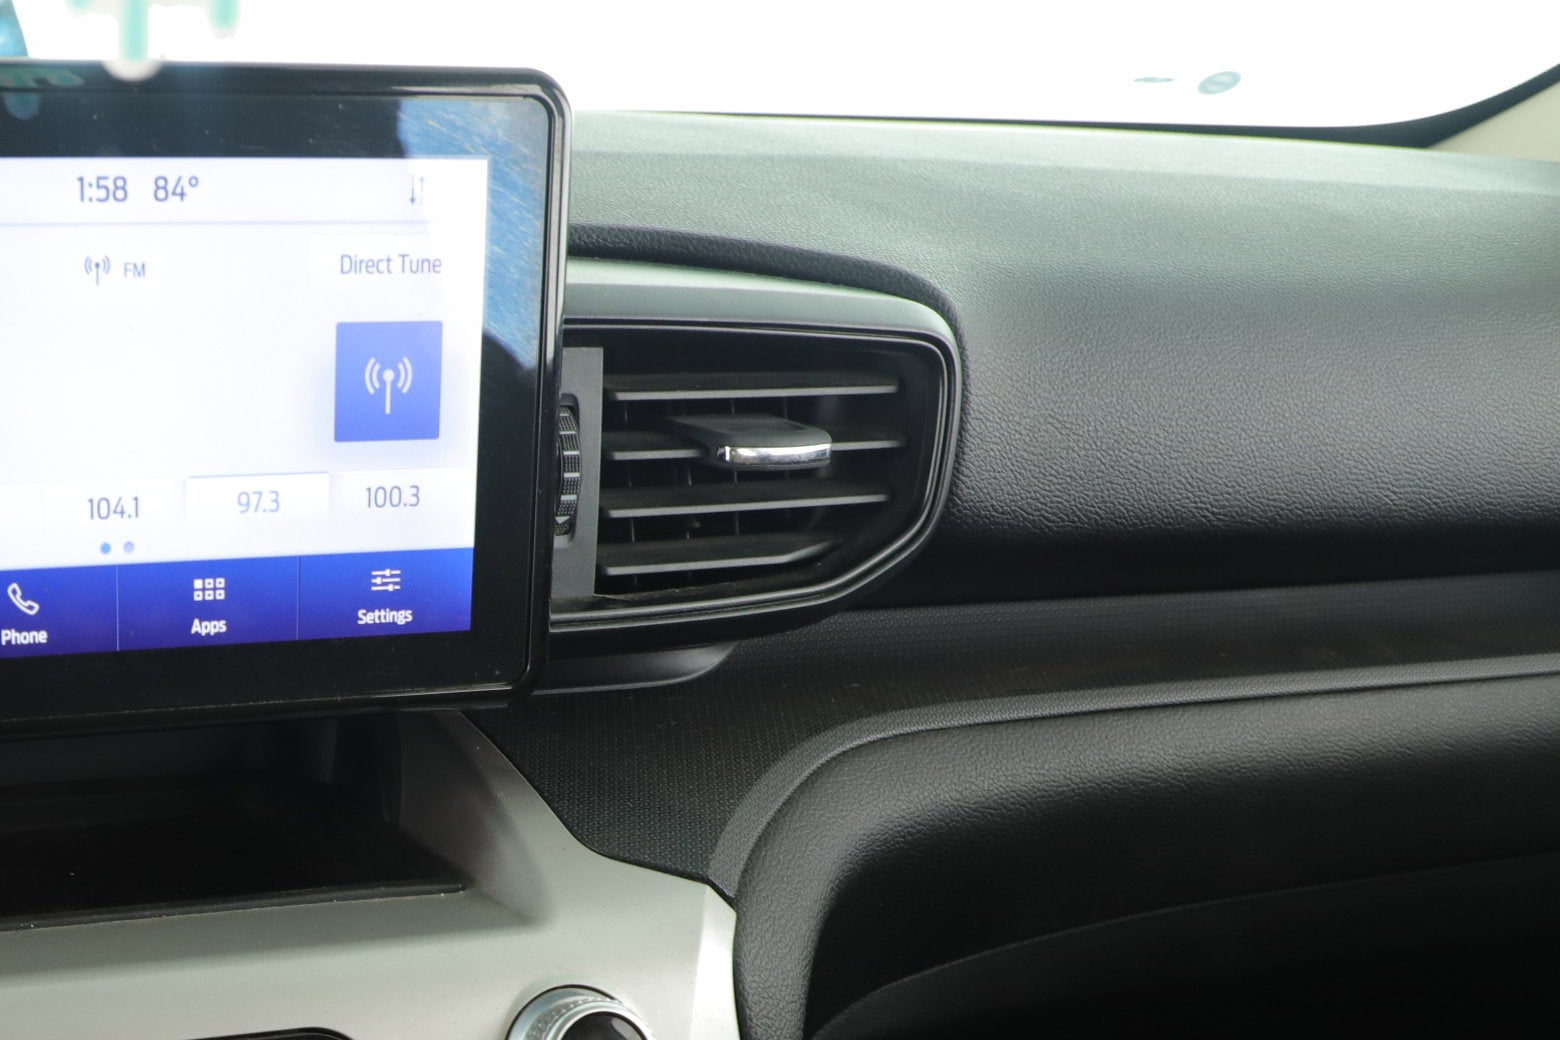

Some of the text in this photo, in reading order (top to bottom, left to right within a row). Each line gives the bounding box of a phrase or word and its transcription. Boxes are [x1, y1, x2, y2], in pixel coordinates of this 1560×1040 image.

[77, 175, 200, 202] 1:58 84°
[123, 263, 147, 278] FM
[340, 254, 442, 275] Direct Tune
[237, 490, 280, 514] 97.3
[365, 485, 420, 509] 100.3
[88, 496, 140, 520] 104.1
[190, 617, 228, 636] Apps
[357, 608, 414, 626] Settings
[0, 629, 49, 645] Phone
